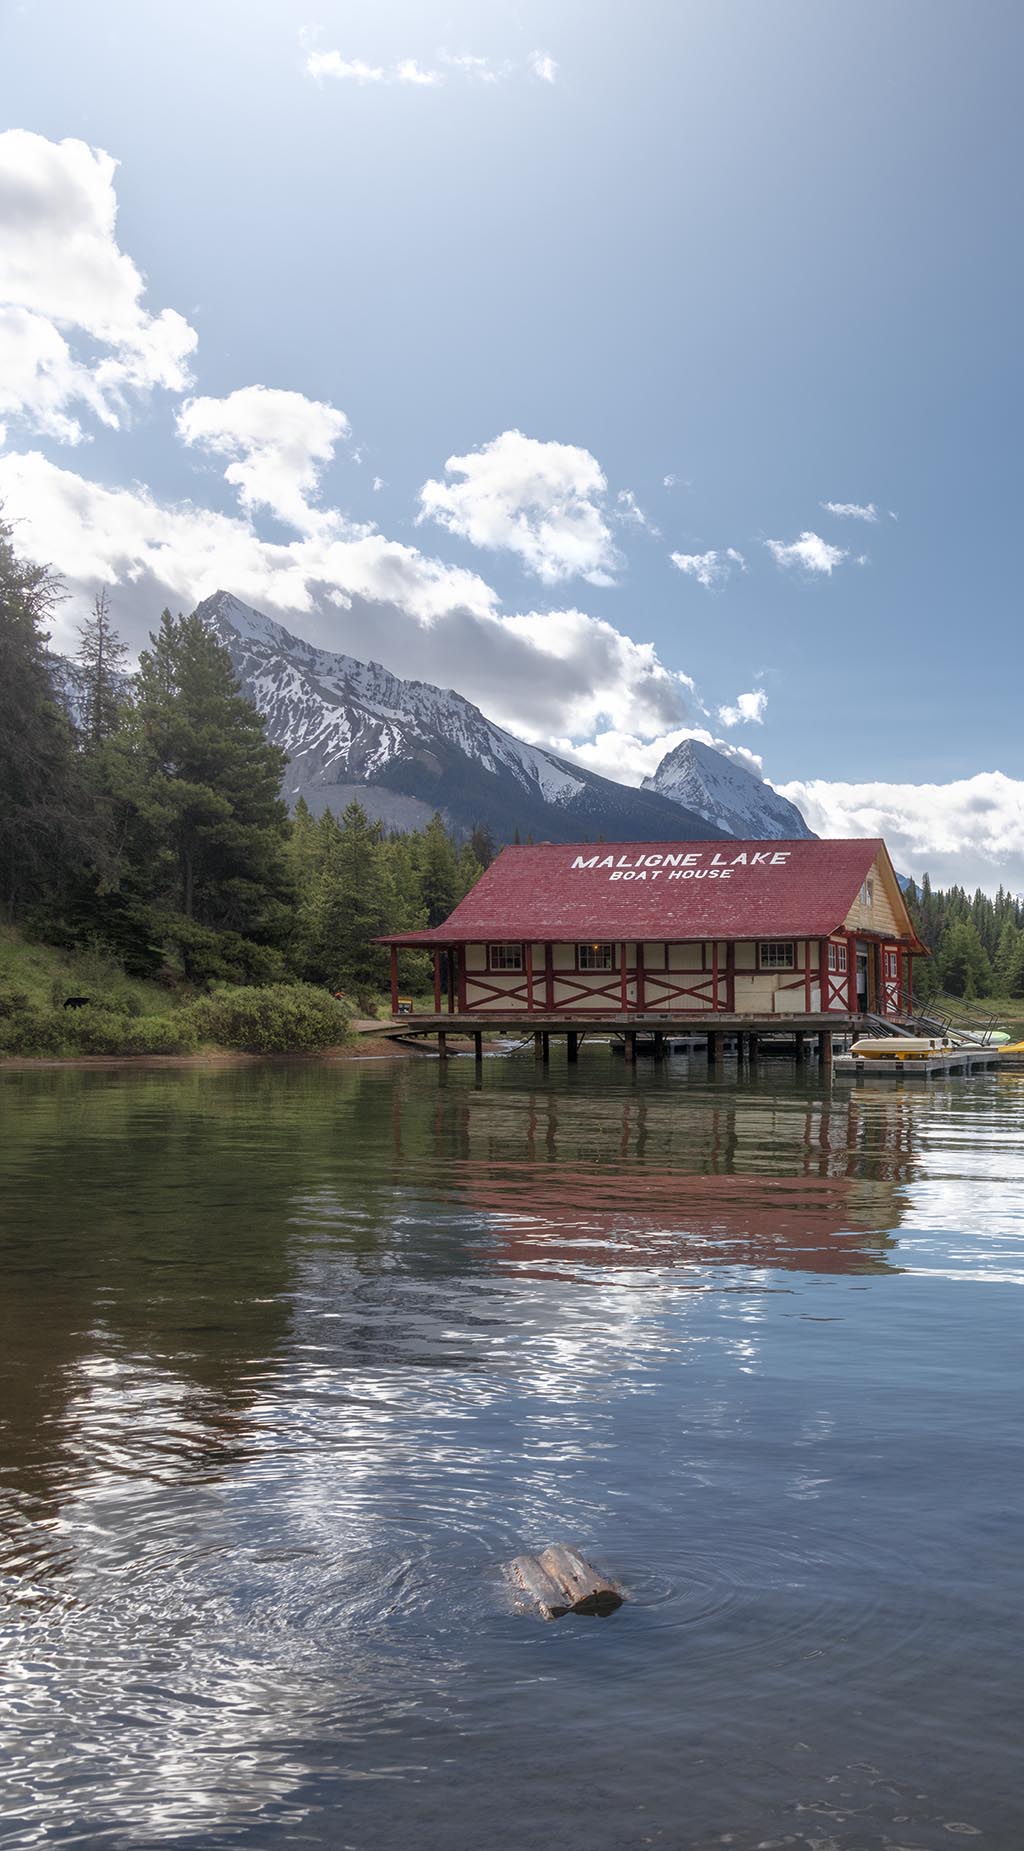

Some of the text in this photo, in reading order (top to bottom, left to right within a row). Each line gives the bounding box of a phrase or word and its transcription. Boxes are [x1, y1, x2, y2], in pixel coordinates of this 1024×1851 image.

[571, 852, 791, 869] MALIGNE LAKE
[609, 869, 735, 881] BOAT HOUSE
